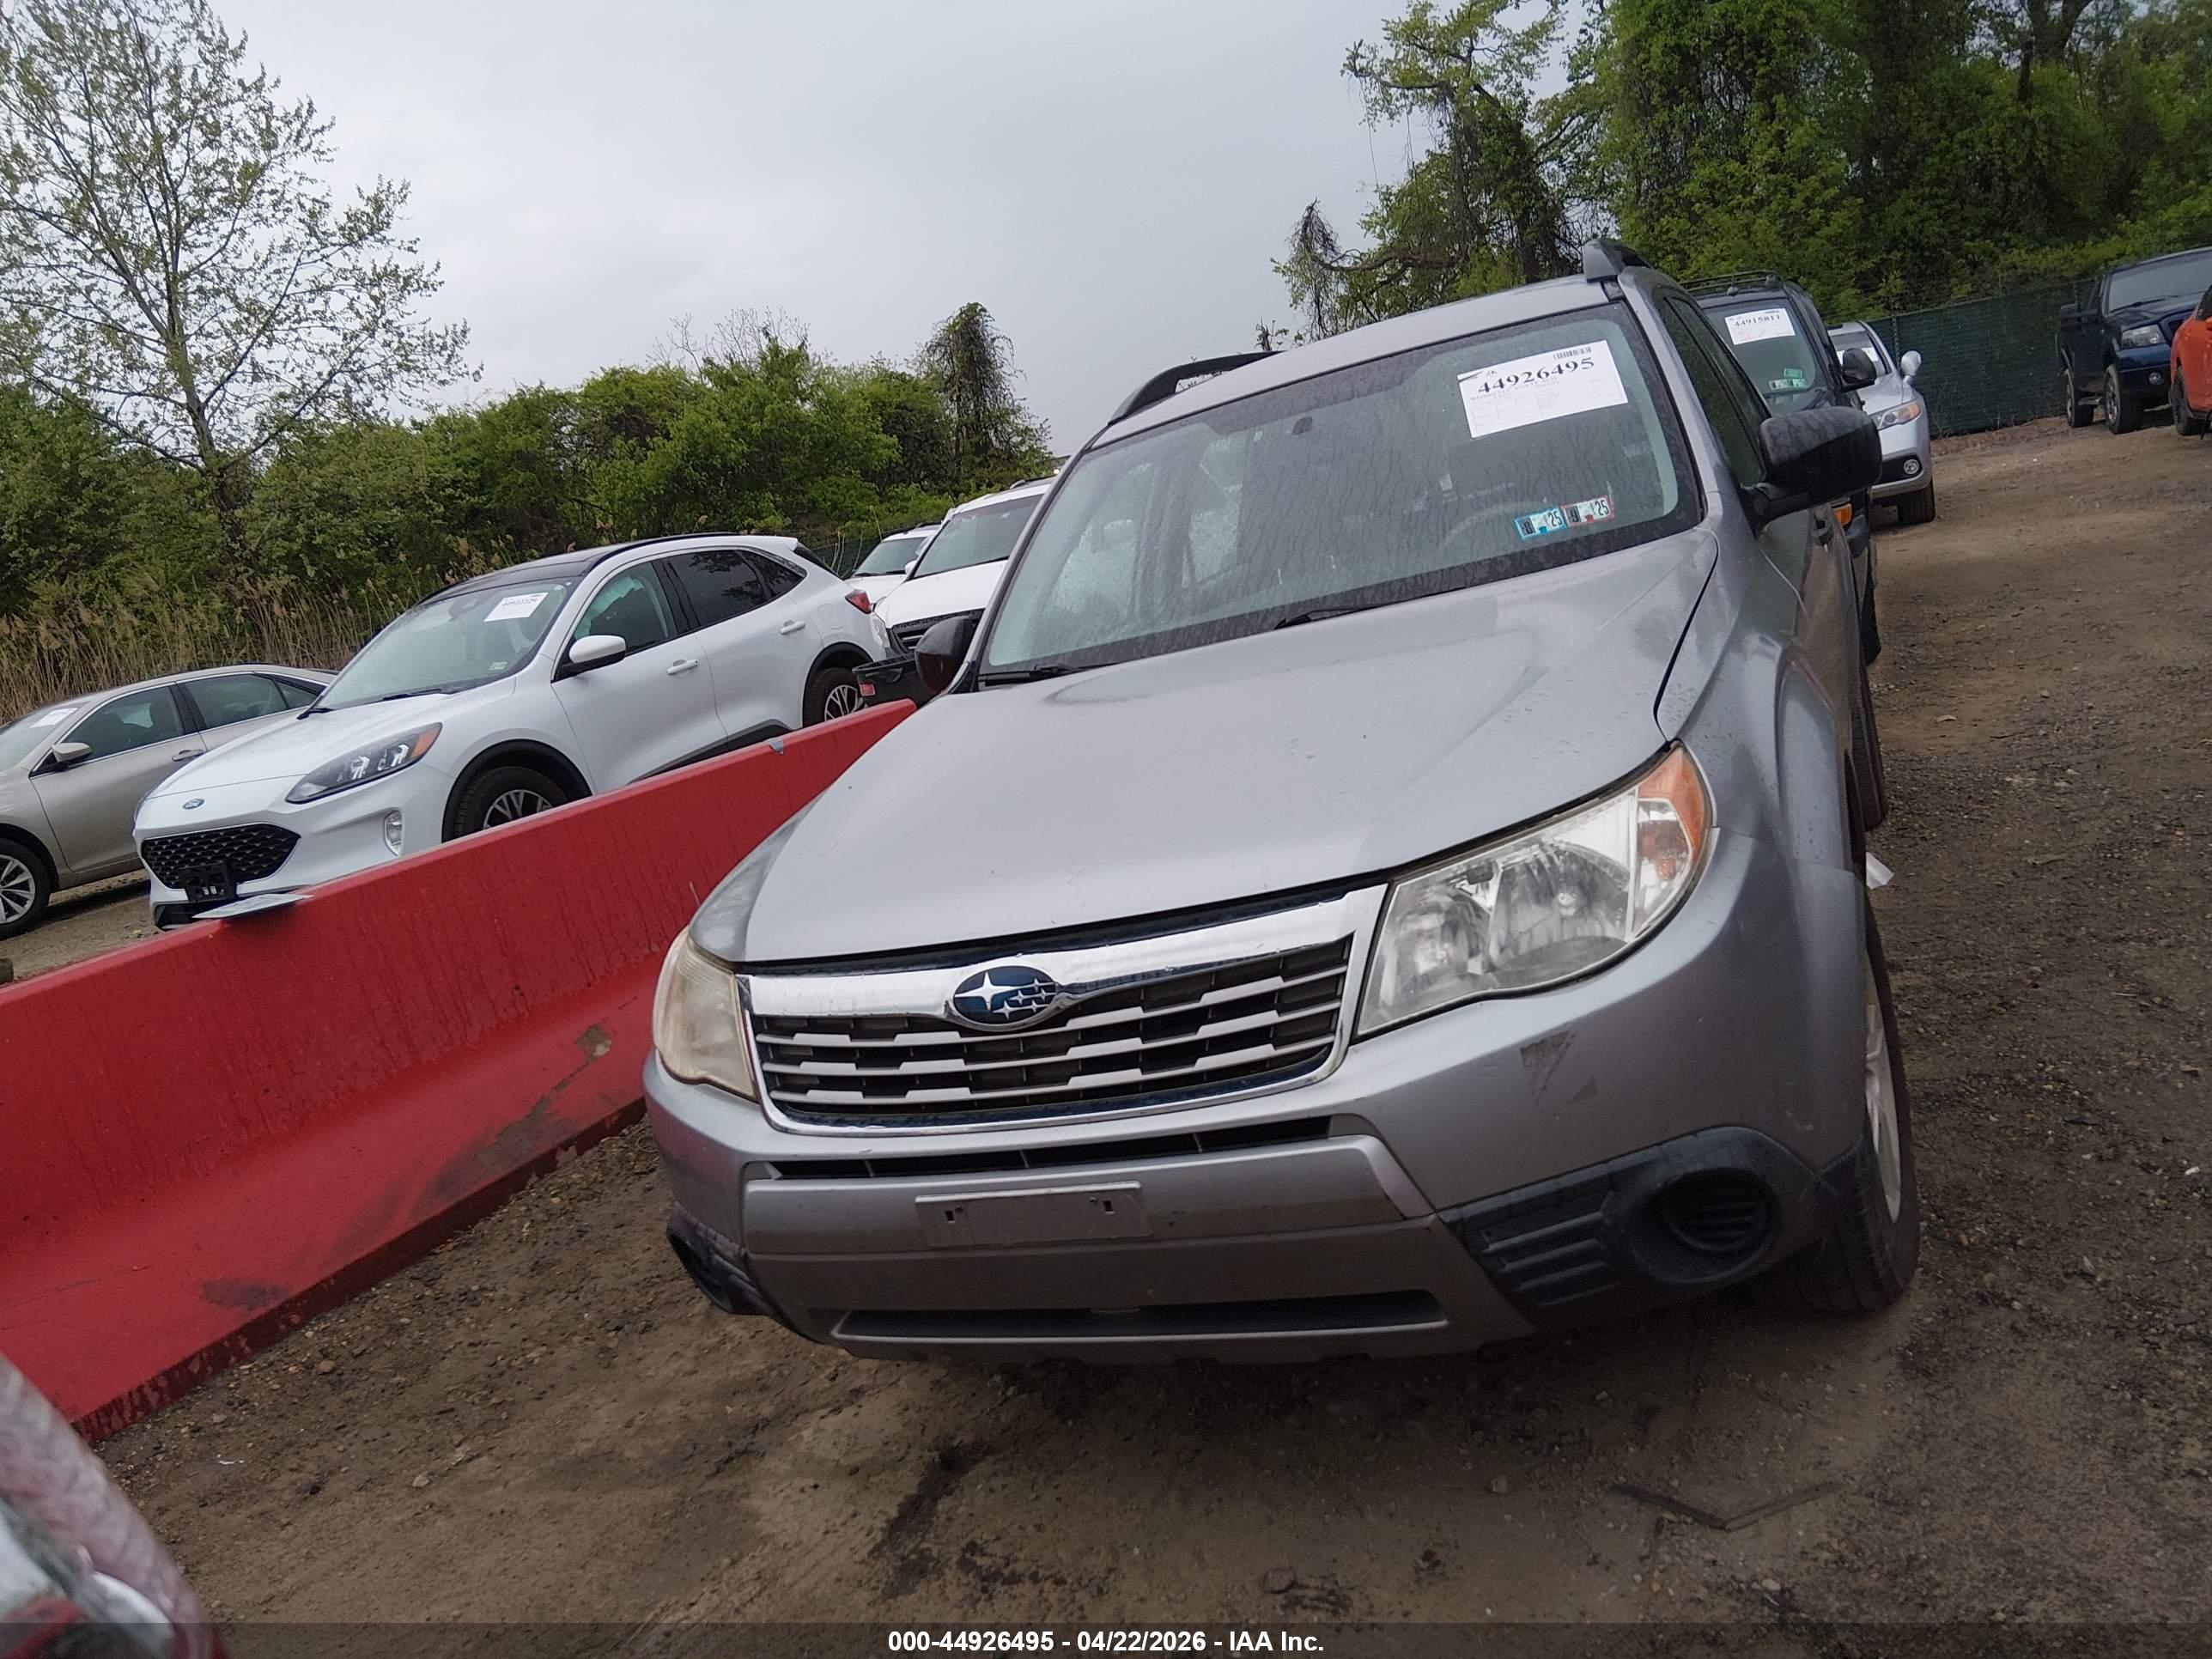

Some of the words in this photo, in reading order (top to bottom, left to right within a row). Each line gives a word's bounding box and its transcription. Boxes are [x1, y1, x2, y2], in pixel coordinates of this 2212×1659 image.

[1478, 357, 1595, 393] 44926495
[1595, 500, 1609, 516] 25
[1548, 511, 1563, 526] 25
